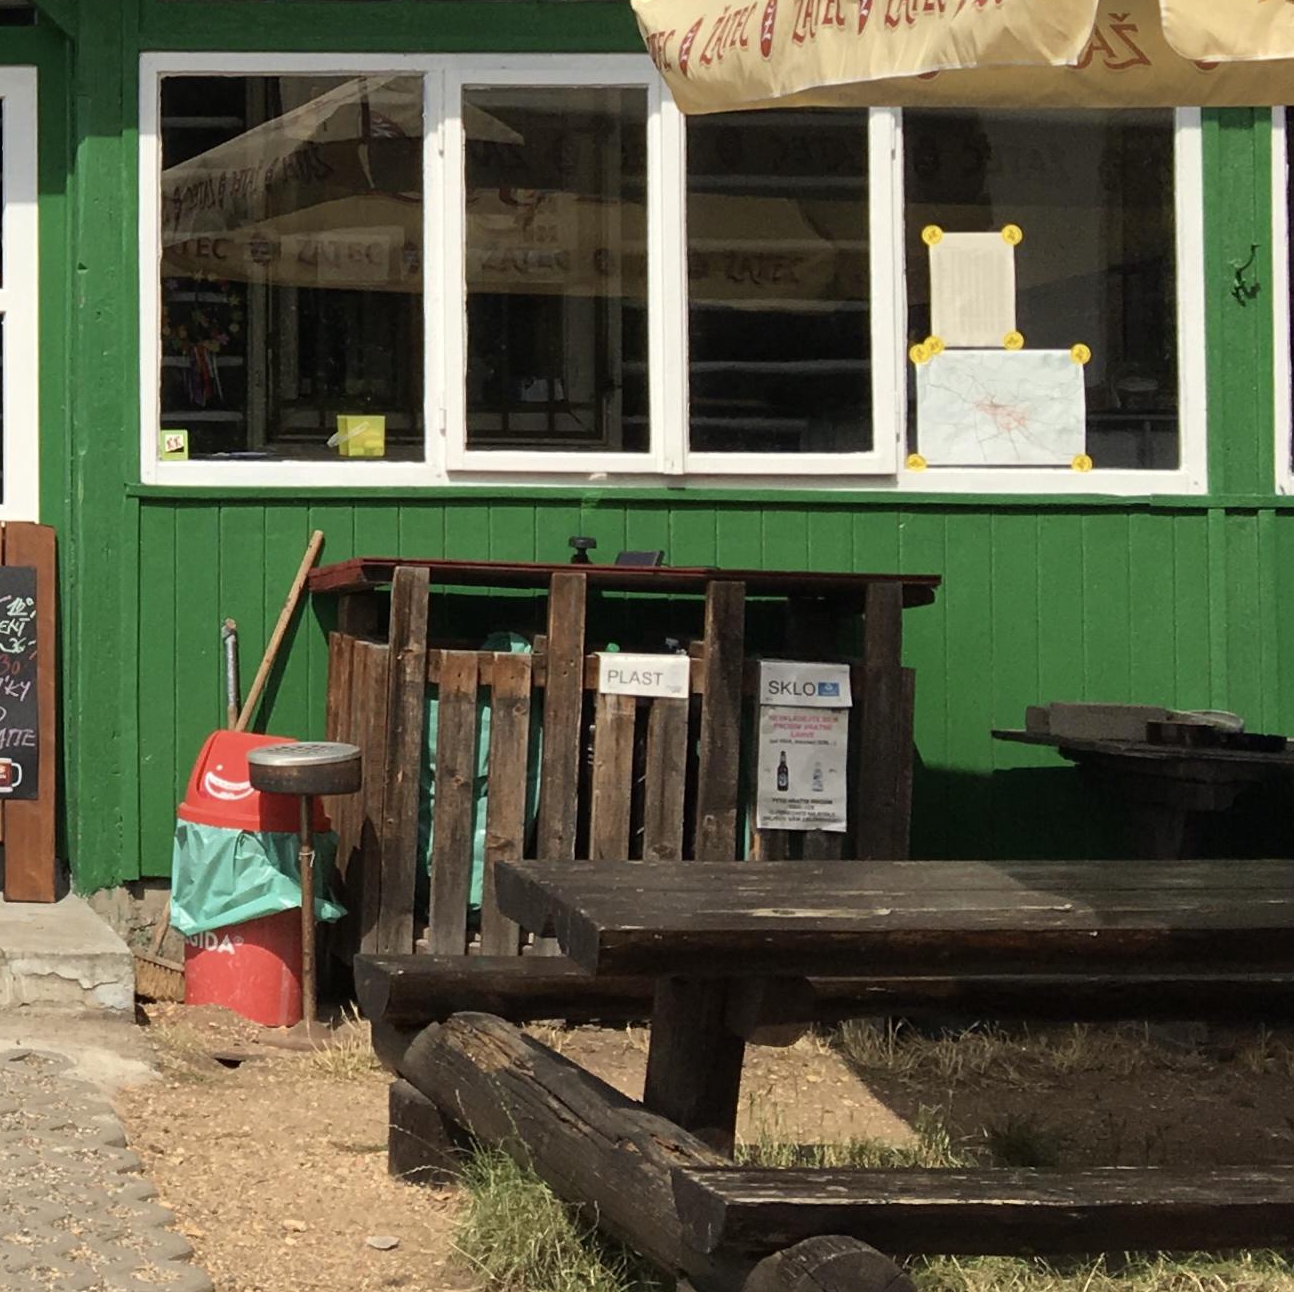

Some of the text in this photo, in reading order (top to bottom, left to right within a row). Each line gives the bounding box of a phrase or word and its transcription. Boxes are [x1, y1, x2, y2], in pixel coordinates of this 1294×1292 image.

[700, 2, 757, 65] ŽATEC
[607, 669, 664, 686] PLAST
[767, 680, 816, 697] SKLO
